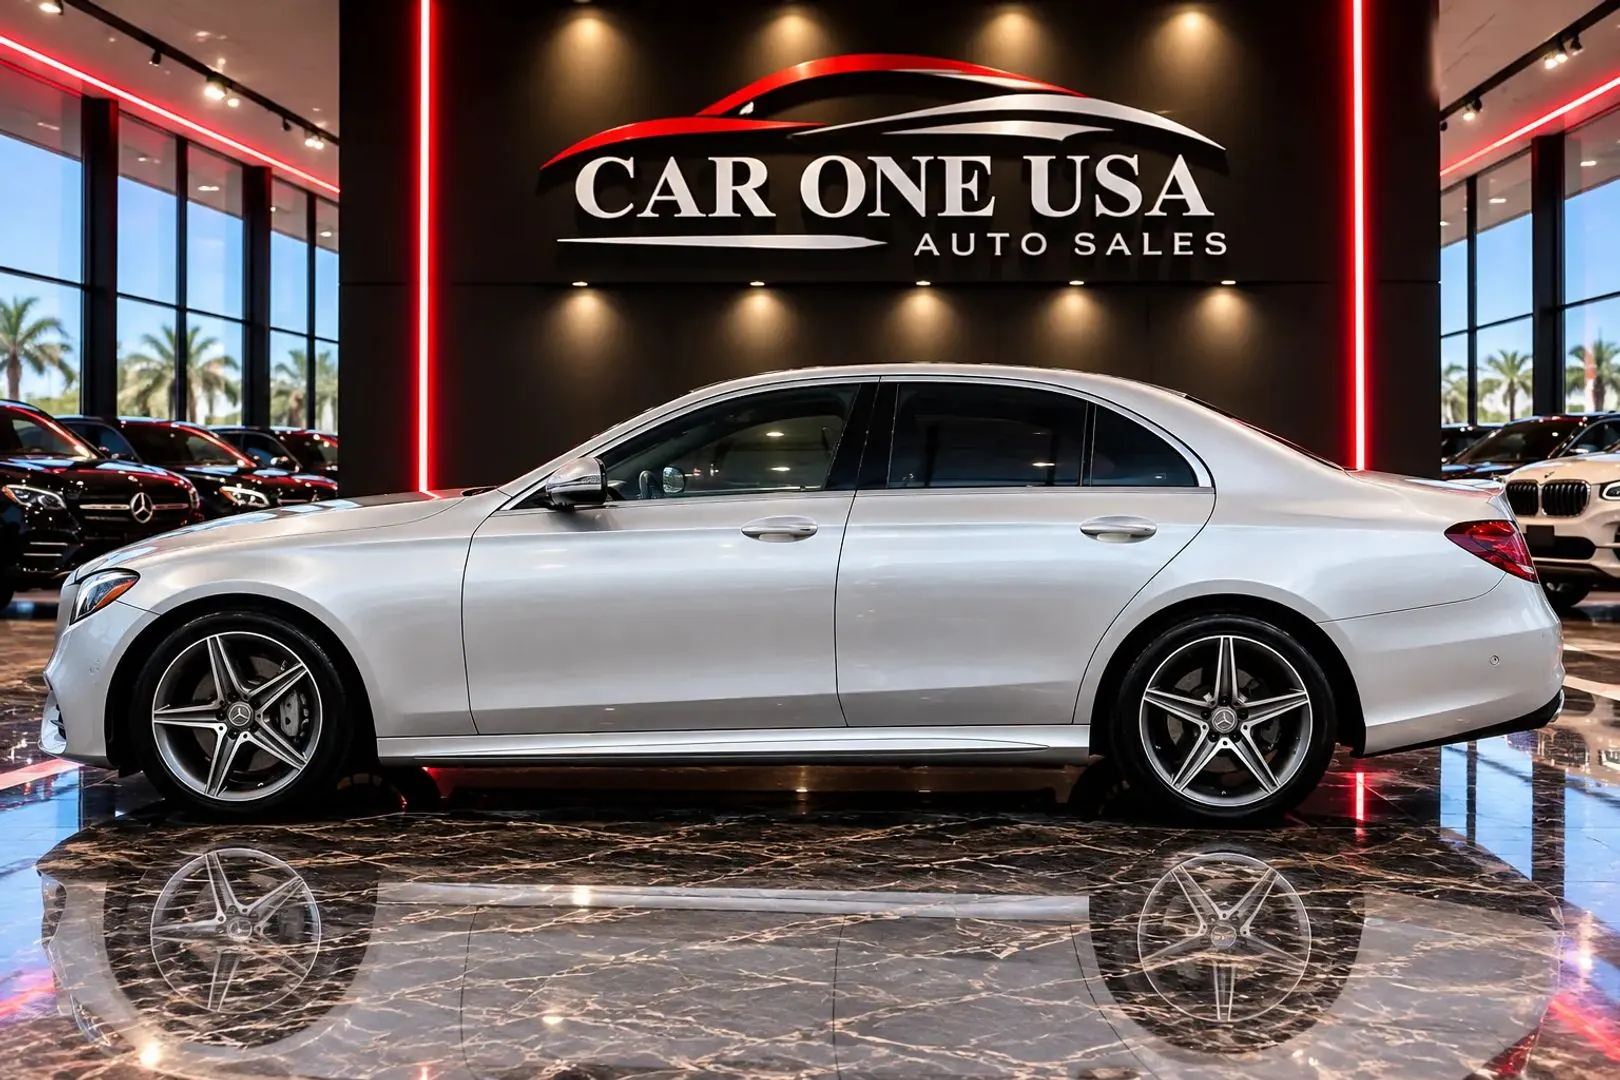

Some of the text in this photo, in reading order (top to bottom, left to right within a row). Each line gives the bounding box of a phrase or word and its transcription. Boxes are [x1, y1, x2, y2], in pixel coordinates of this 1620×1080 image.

[574, 154, 1215, 219] CAR ONE USA
[914, 231, 1228, 257] AUTO SALES
